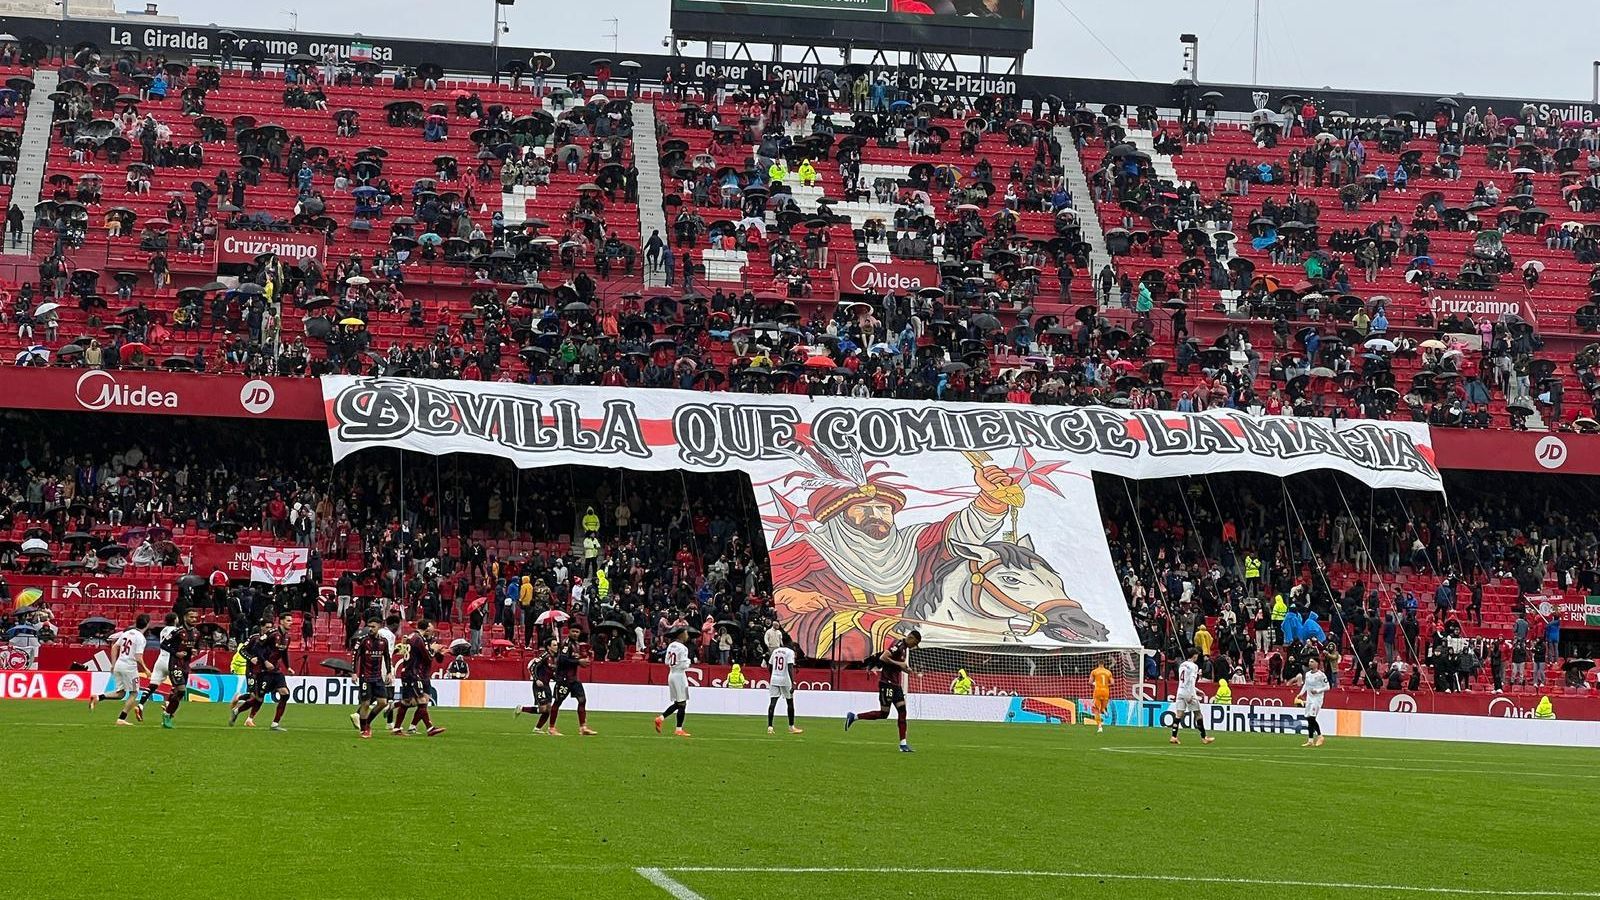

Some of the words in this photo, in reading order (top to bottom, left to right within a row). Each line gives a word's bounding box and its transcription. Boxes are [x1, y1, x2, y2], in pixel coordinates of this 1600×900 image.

[110, 27, 132, 45] La
[143, 28, 208, 50] Giralda
[721, 65, 749, 80] ver
[772, 65, 818, 84] Sevill
[877, 70, 1016, 96] Sáchez-Pizjuán
[224, 235, 318, 260] Cruzcampo
[857, 267, 921, 290] Midea
[1431, 295, 1520, 315] Cruzcampo
[85, 378, 179, 409] Midea
[244, 387, 270, 405] JD
[333, 377, 653, 459] SEVILLA
[672, 402, 802, 468] QUE
[810, 406, 1139, 460] COMIENCE
[1132, 409, 1245, 457] LA
[1230, 411, 1442, 481] MAGIA
[1539, 443, 1563, 460] JD
[84, 582, 161, 600] CaixaBank
[121, 637, 133, 656] 36
[774, 656, 785, 671] 19
